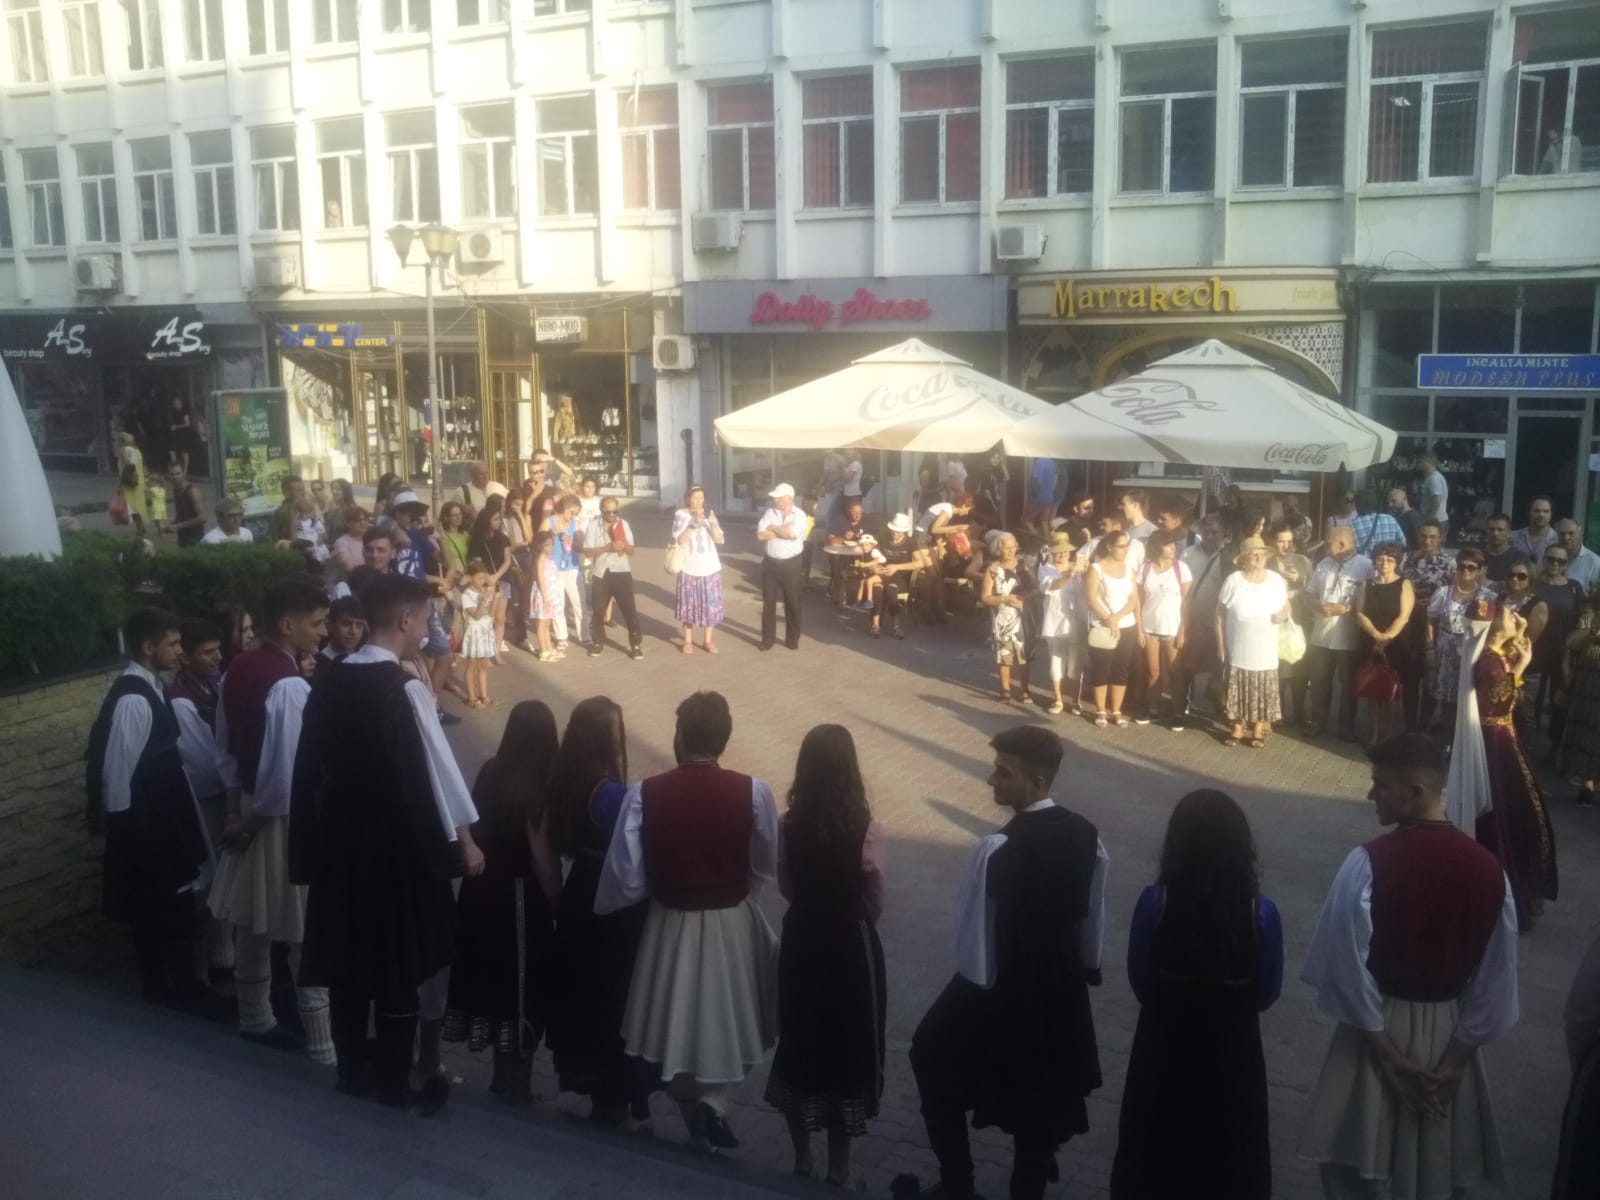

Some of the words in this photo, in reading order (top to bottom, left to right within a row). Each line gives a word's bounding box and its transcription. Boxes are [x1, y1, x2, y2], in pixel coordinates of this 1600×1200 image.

[1052, 276, 1240, 318] Marrakech
[355, 337, 389, 347] CENTER
[4, 349, 27, 359] beauty
[28, 349, 45, 359] shop
[1466, 357, 1569, 368] INCALTAMINTE
[1432, 371, 1527, 386] MODERN
[1537, 371, 1596, 387] PLUS
